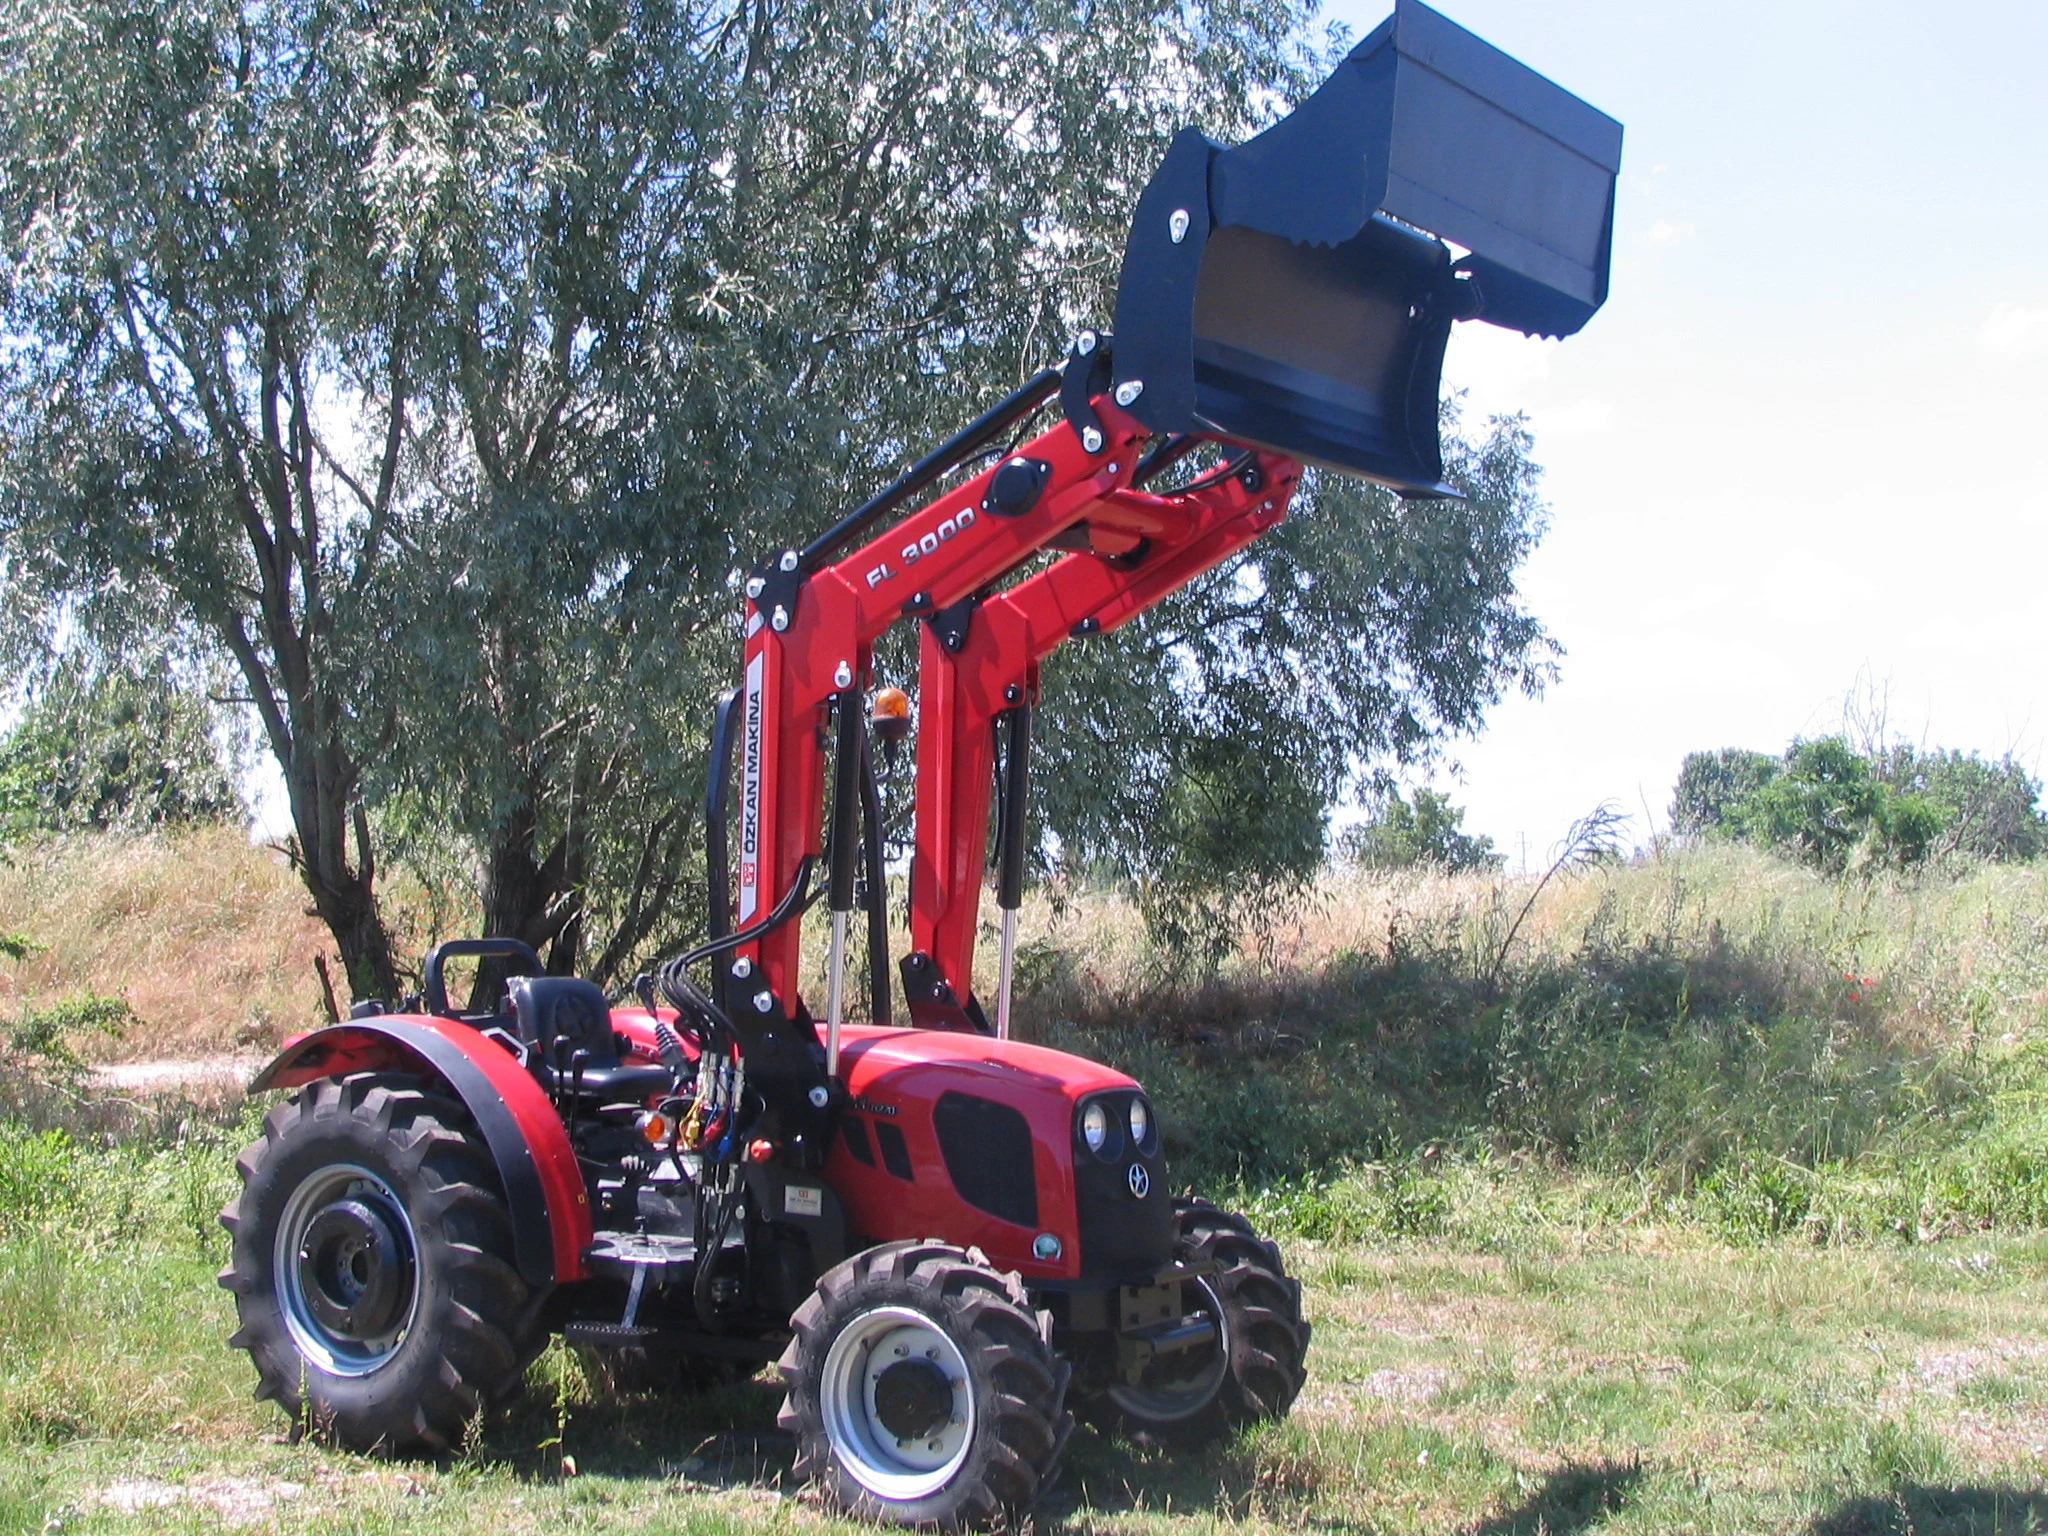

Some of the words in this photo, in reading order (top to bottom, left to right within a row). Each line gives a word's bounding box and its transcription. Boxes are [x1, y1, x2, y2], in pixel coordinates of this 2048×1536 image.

[866, 563, 897, 588] FL
[901, 507, 975, 564] 3000
[743, 781, 758, 854] ÖZKAN
